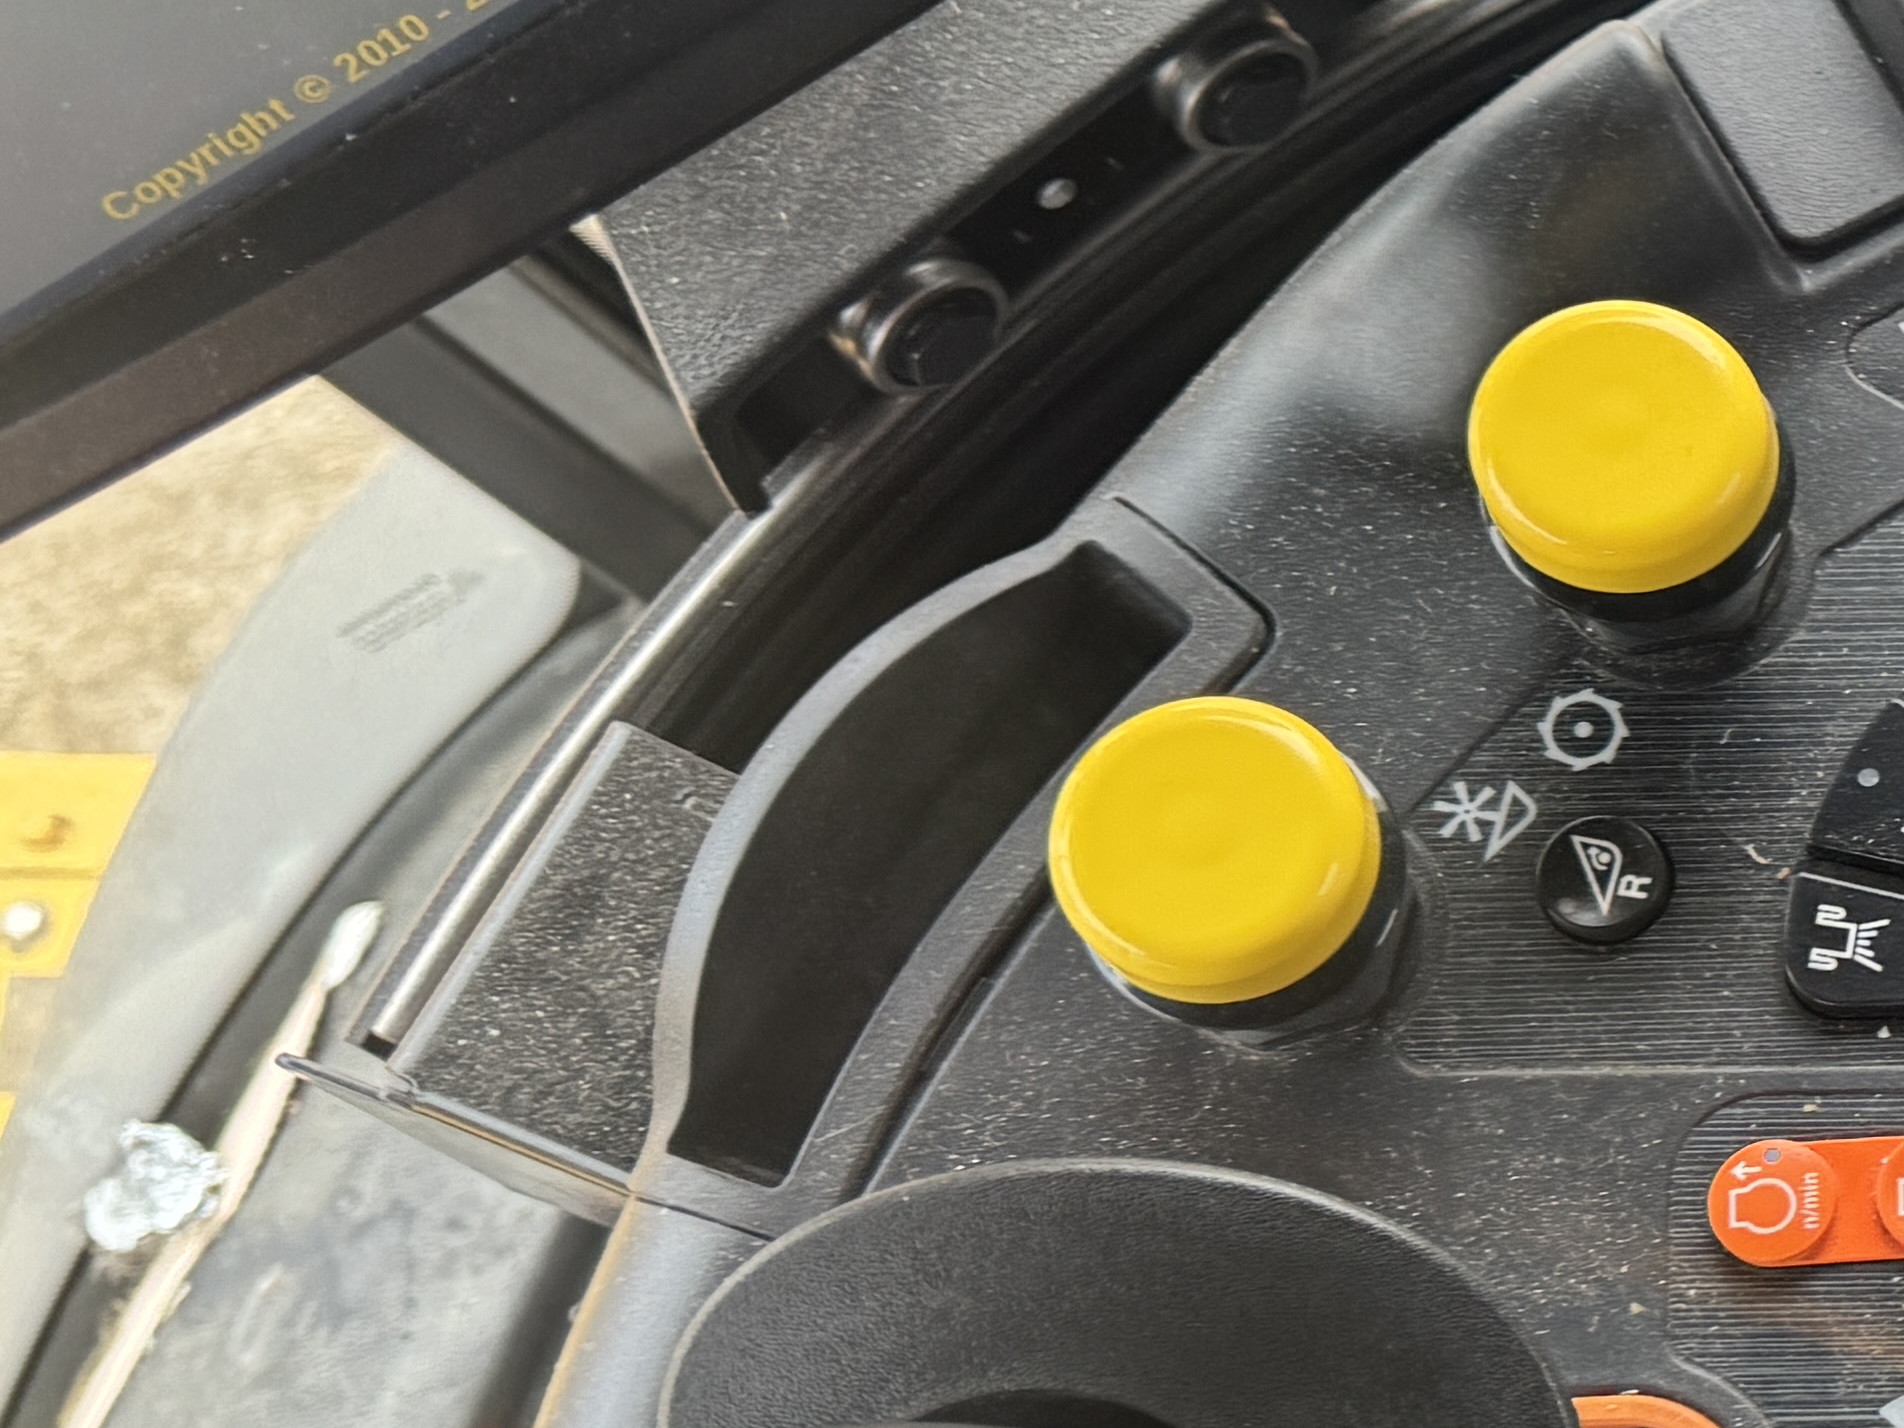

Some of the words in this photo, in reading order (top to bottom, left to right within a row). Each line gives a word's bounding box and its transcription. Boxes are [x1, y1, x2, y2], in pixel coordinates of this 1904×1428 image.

[102, 97, 295, 222] Copyright
[333, 14, 430, 83] 2010
[1617, 874, 1653, 899] R
[1802, 1172, 1819, 1229] n/min
